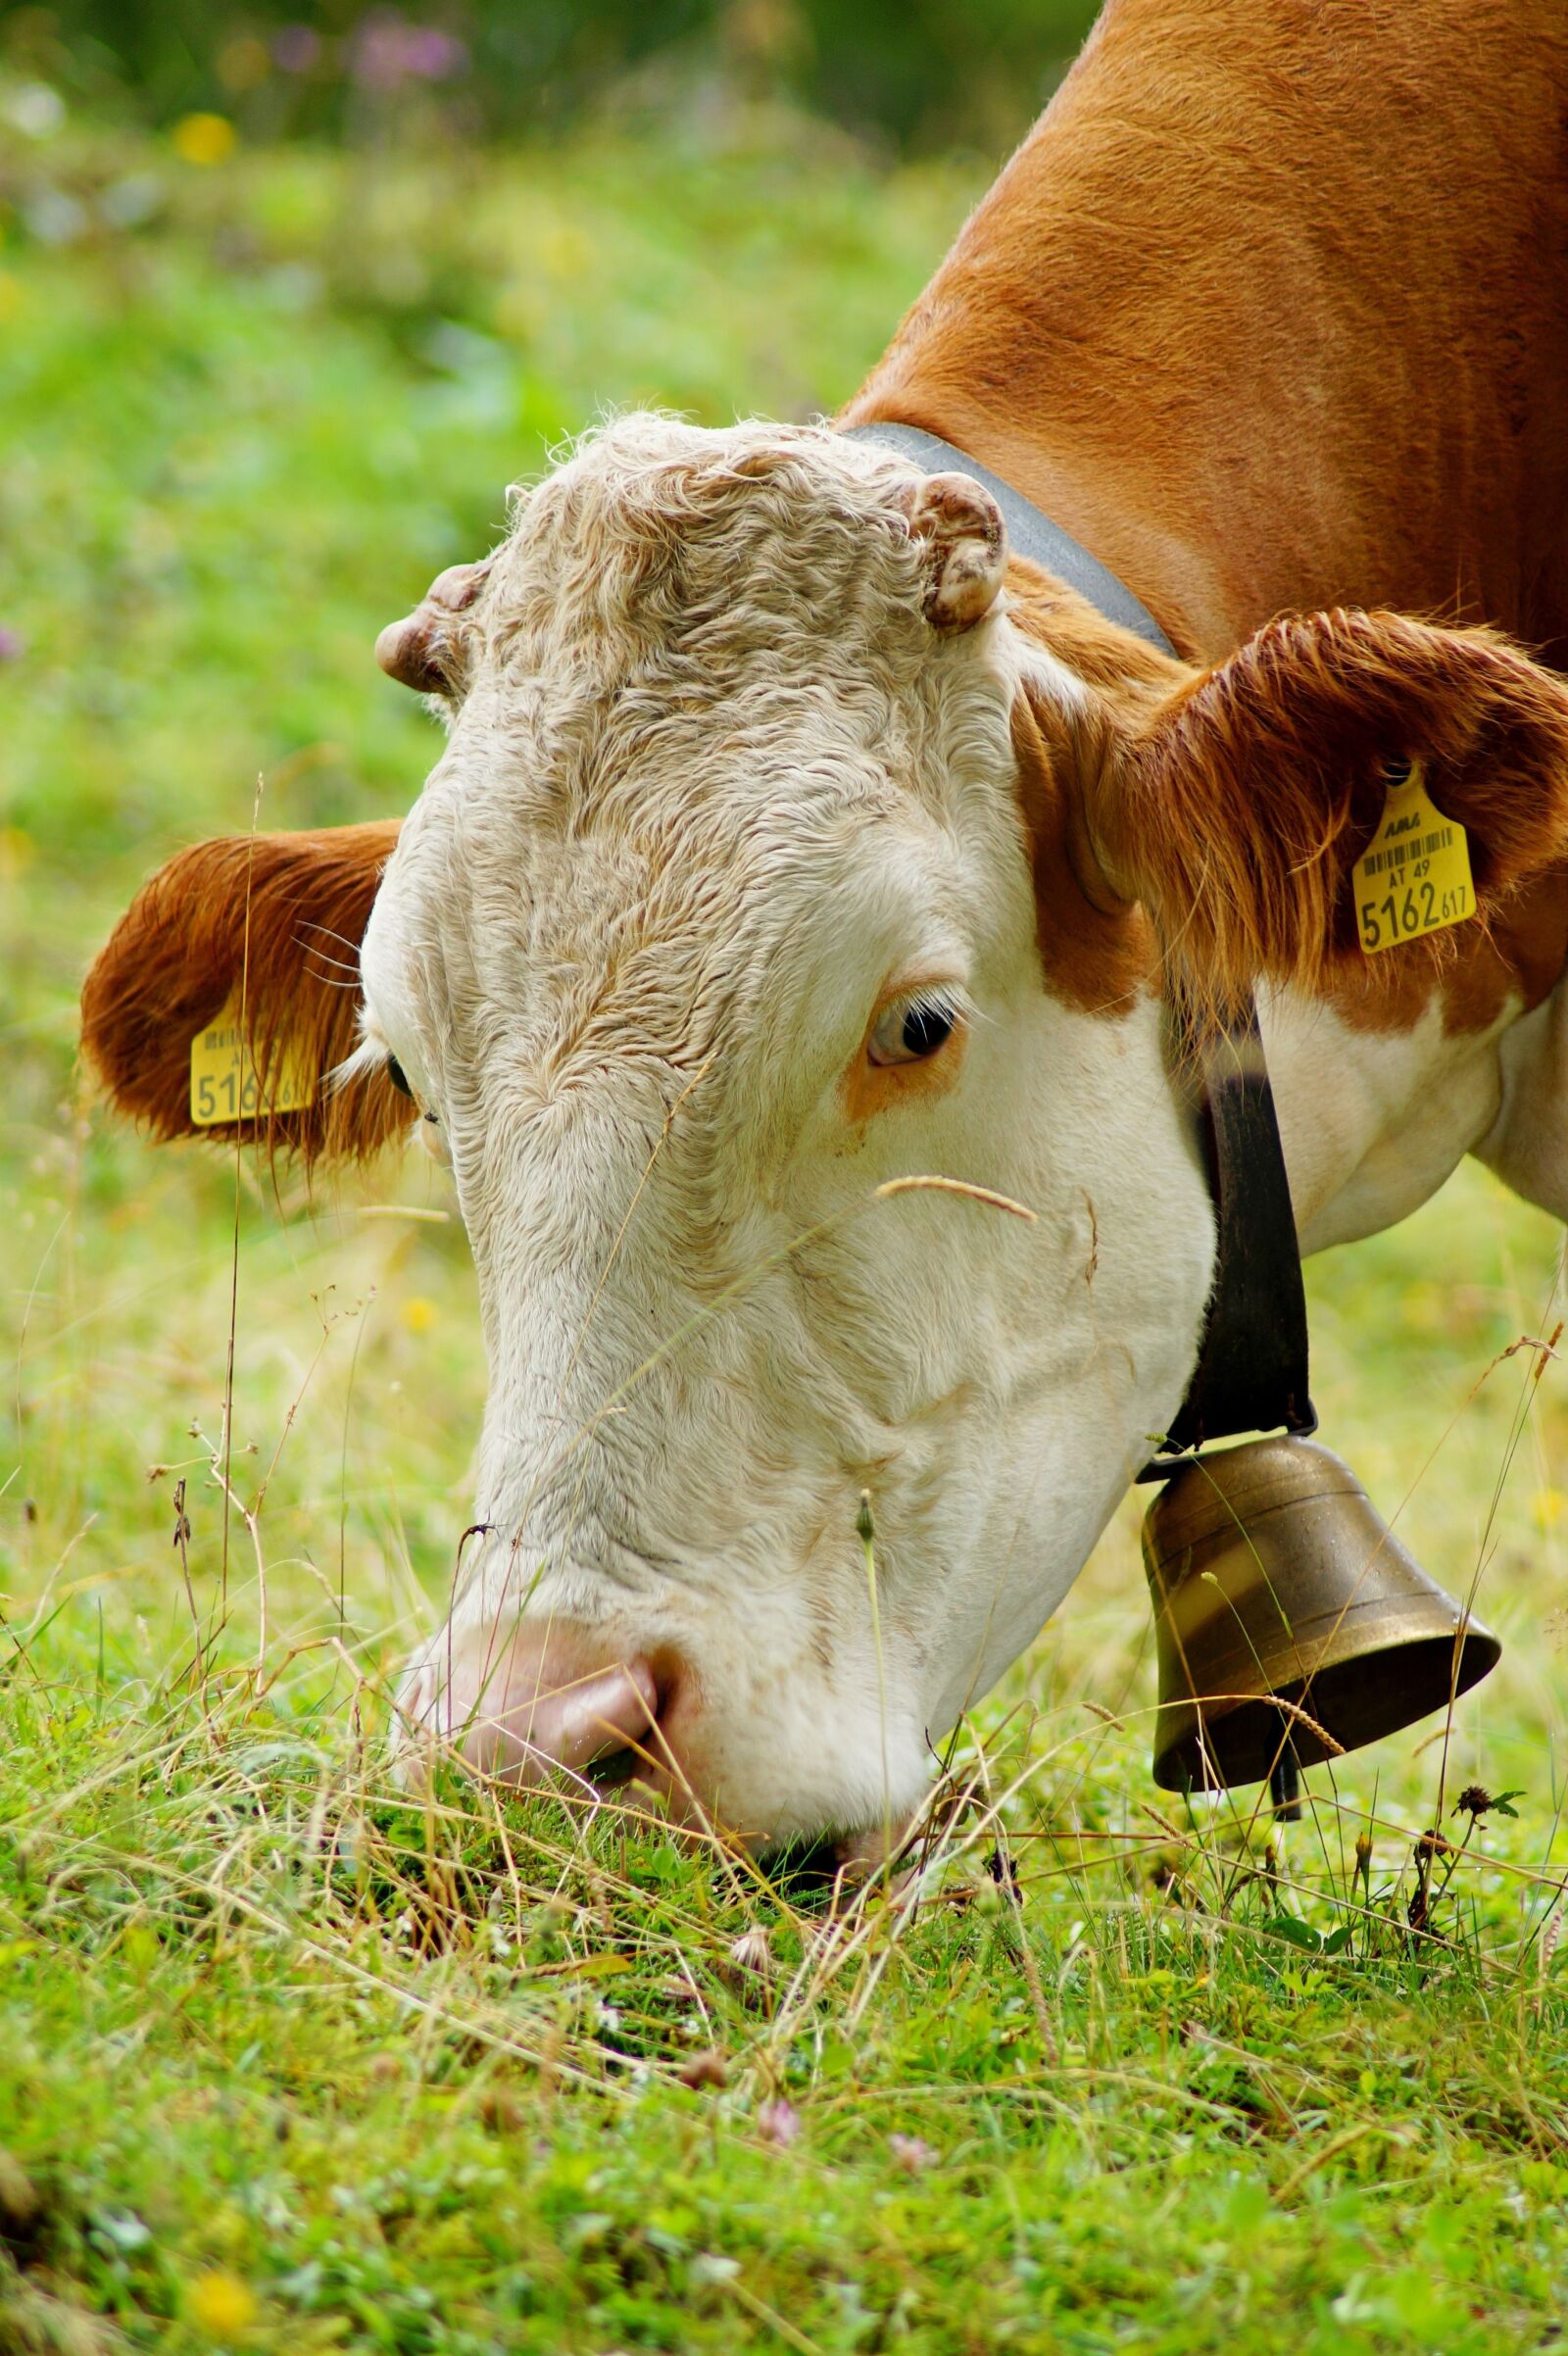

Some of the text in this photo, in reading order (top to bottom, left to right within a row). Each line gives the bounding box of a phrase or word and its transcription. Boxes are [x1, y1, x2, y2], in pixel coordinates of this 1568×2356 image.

[1389, 859, 1431, 889] AT 49
[1361, 881, 1466, 948] 5162 617
